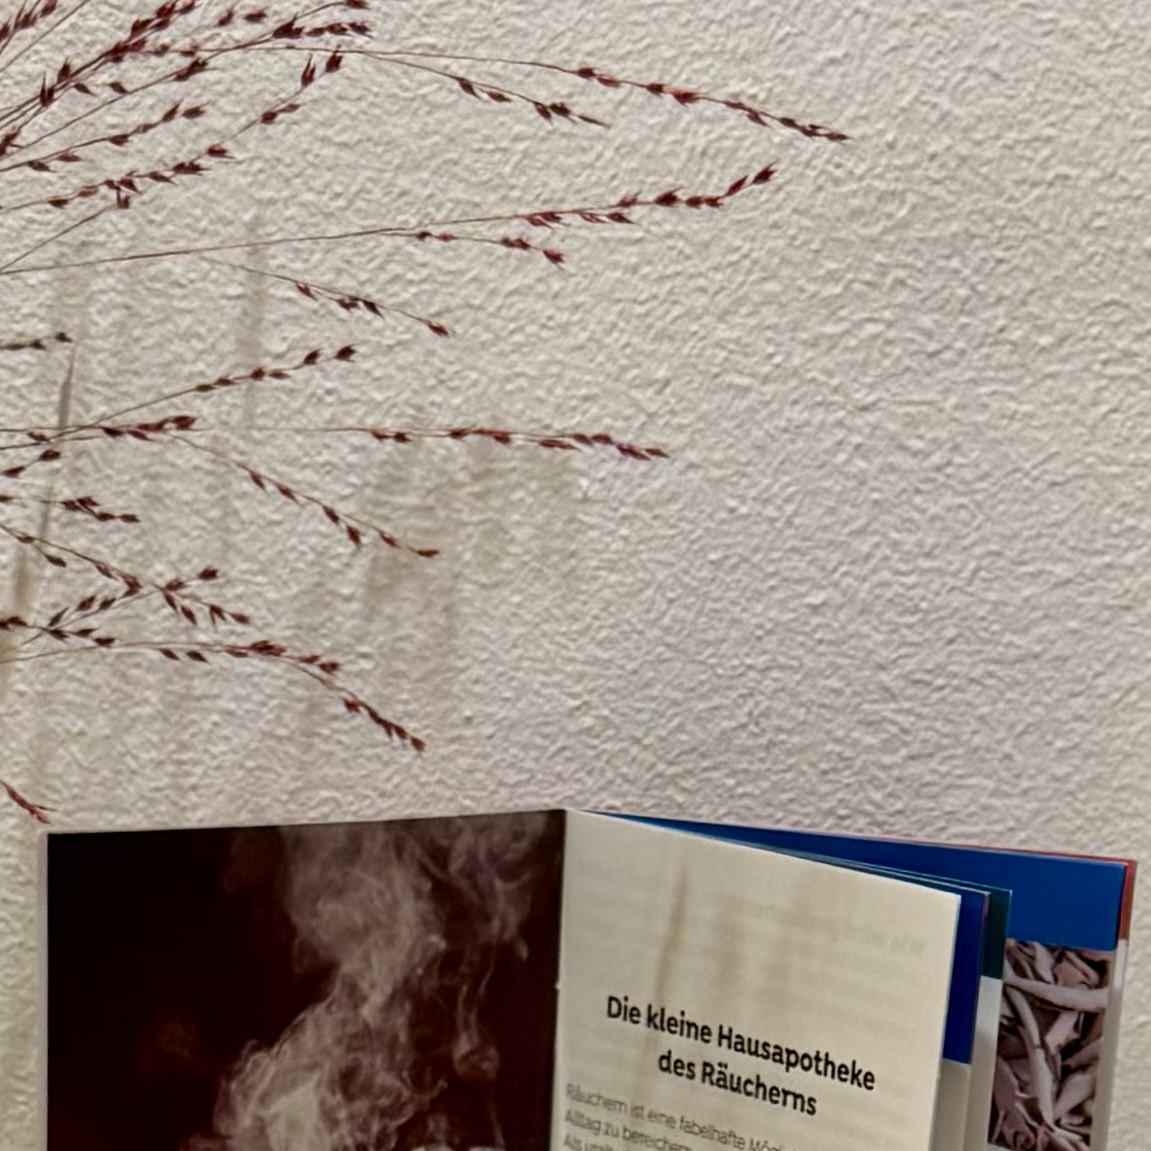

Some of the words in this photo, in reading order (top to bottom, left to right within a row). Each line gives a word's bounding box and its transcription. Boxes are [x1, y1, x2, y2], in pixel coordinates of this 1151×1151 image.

[606, 995, 641, 1024] Die
[646, 1003, 712, 1044] kleine
[717, 1024, 876, 1091] Hausapotheke
[658, 1050, 696, 1081] des
[701, 1061, 817, 1116] Räucherns
[563, 1133, 582, 1151] Als
[564, 1109, 601, 1136] Alltag
[602, 1121, 619, 1138] zu
[646, 1109, 676, 1129] eine
[679, 1115, 745, 1150] fabelhafte
